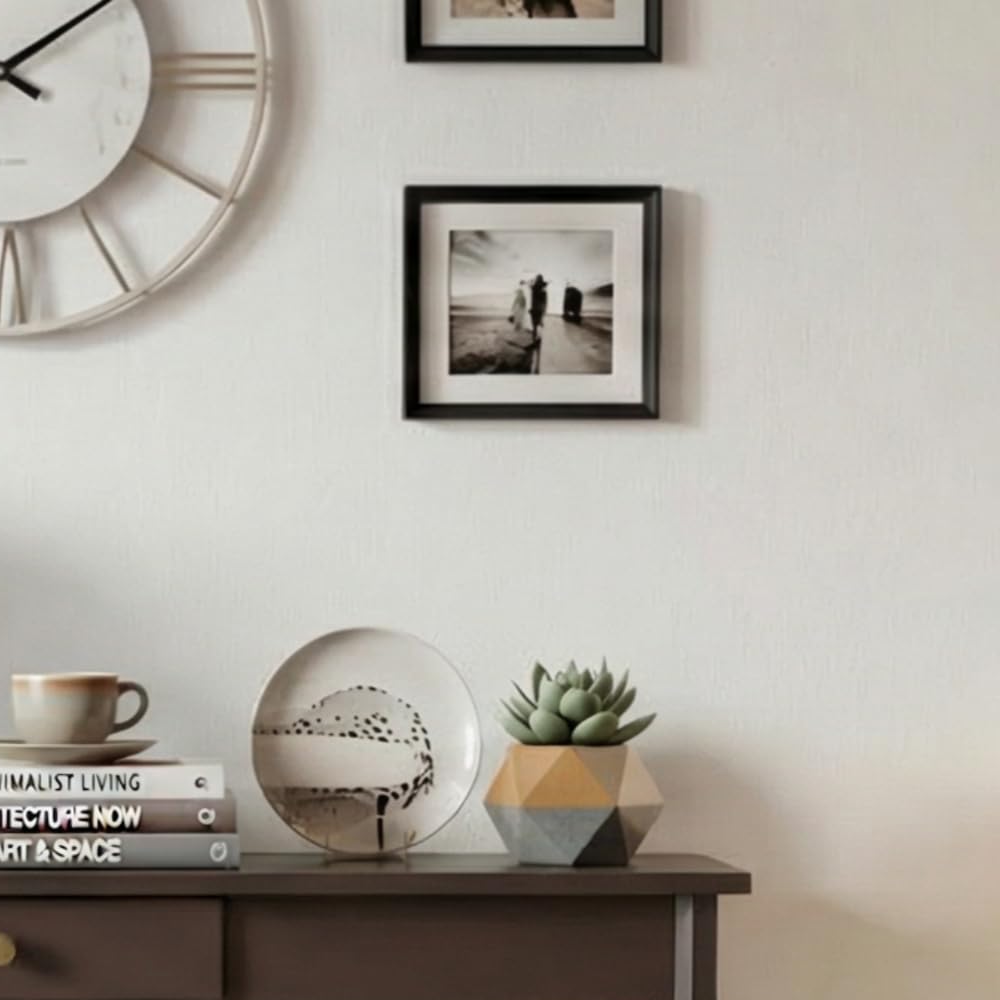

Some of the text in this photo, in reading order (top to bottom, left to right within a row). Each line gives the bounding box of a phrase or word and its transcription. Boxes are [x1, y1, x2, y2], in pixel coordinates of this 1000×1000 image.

[81, 772, 141, 792] LIVING
[92, 804, 142, 829] NOW
[35, 838, 50, 863] &
[51, 838, 122, 863] SPACE
